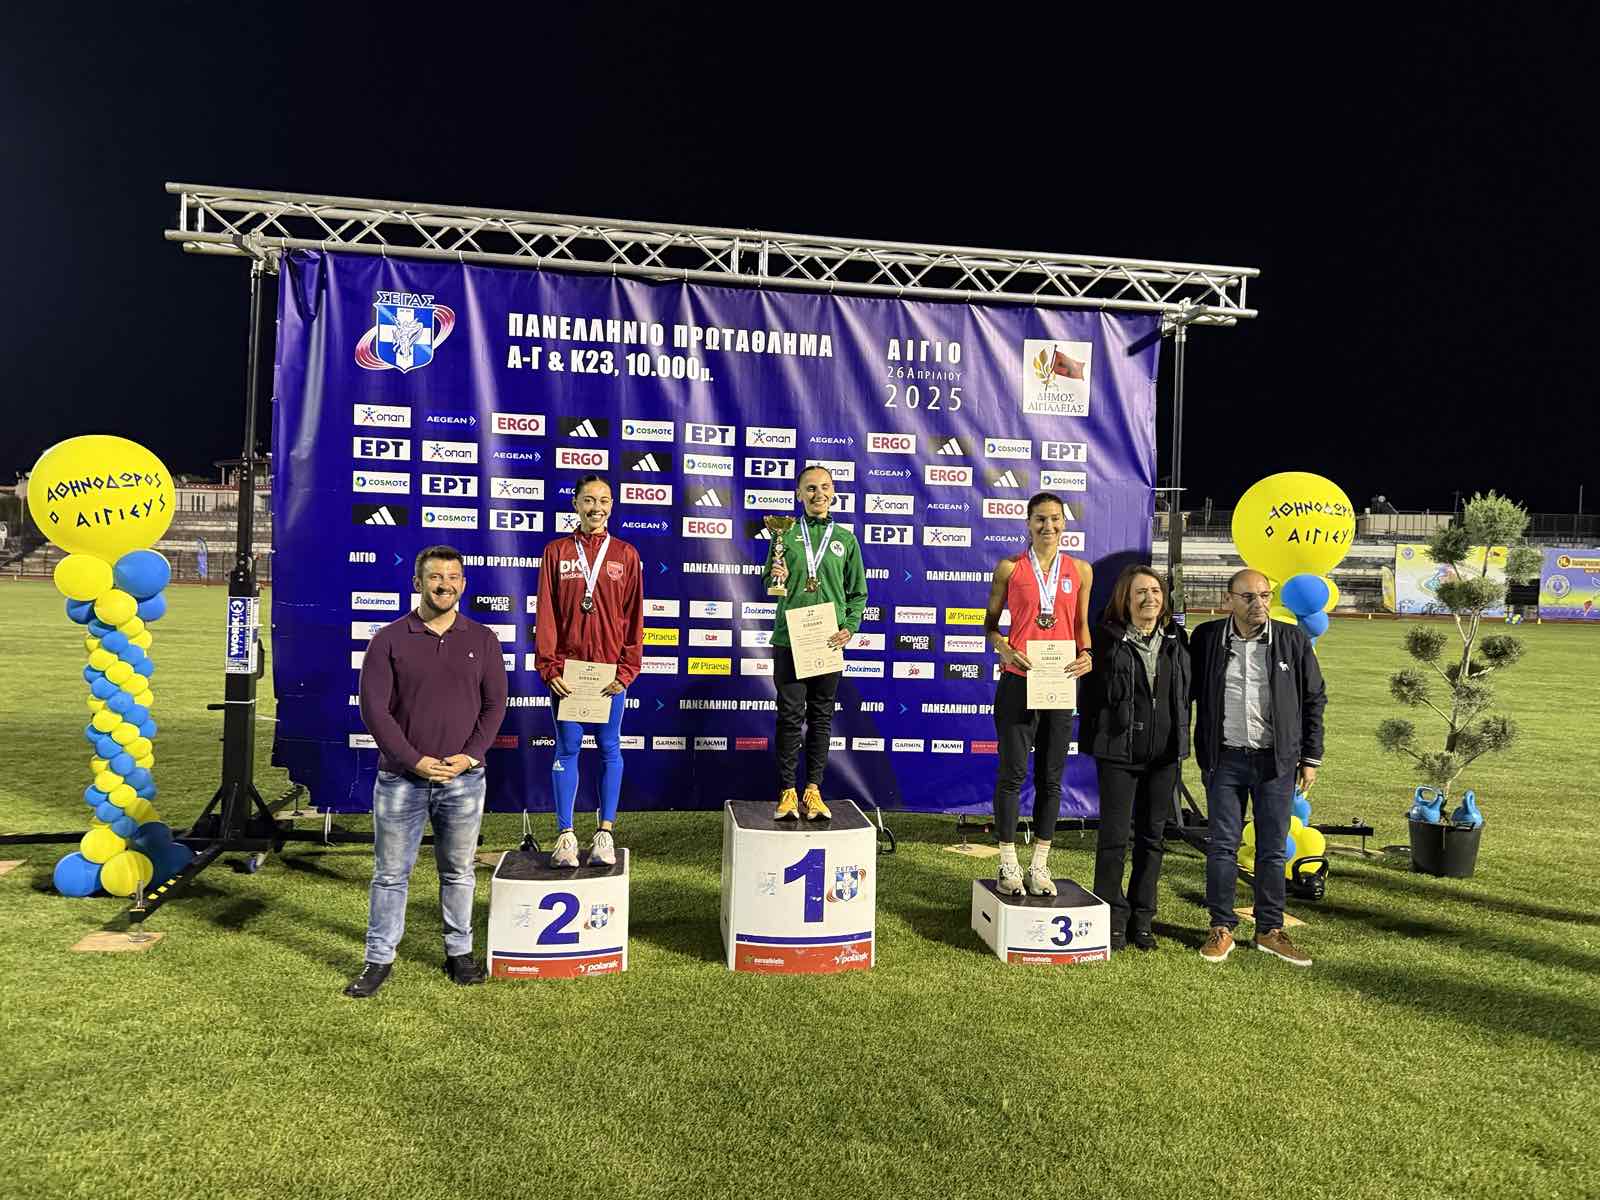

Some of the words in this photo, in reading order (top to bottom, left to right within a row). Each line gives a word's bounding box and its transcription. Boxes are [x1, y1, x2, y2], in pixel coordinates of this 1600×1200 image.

[376, 290, 435, 307] ΣΕΓΑΣ
[508, 313, 664, 346] ΠΑΝΕΛΛΗΝΙΟ
[674, 325, 833, 358] ΠΡΩΤΑΘΛΗΜΑ
[887, 339, 961, 364] ΑΙΓΙΟ
[507, 346, 542, 370] Α-Γ
[548, 351, 564, 372] &
[570, 349, 620, 376] Κ23,
[885, 384, 962, 411] 2025
[427, 415, 467, 425] AEGEAN
[498, 417, 540, 432] ERGO
[636, 428, 672, 436] COSMOTE
[809, 436, 846, 445] AEGEAN
[872, 437, 911, 450] ERGO
[493, 452, 533, 460] AEGEAN
[561, 452, 603, 466] ERGO
[868, 469, 904, 477] AEGEAN
[929, 470, 967, 482] ERGO
[369, 479, 408, 488] COSMOTE
[626, 487, 666, 501] ERGO
[758, 496, 793, 504] COSMOTE
[927, 503, 962, 511] AEGEAN
[988, 503, 1024, 516] ERGO
[437, 514, 476, 523] COSMOTE
[622, 521, 661, 530] AEGEAN
[688, 521, 727, 535] ERGO
[984, 535, 1018, 543] AEGEAN
[349, 551, 376, 563] ΑΙΓΙΟ
[683, 562, 741, 574] ΠΑΝΕΛΛΗΝΙΟ
[866, 568, 889, 579] ΑΙΓΙΟ
[926, 570, 983, 582] ΠΑΝΕΛΛΗΝΙΟ
[476, 596, 510, 604] POWER
[957, 610, 985, 620] Piraeus
[648, 632, 678, 642] Piraeus
[900, 635, 929, 644] POWER
[700, 661, 729, 671] Piraeus
[950, 664, 979, 673] POWER
[680, 699, 738, 710] ΠΑΝΕΛΛΗΝΙΟ
[860, 702, 884, 712] ΑΙΓΙΟ
[921, 703, 977, 714] ΠΑΝΕΛΛΗΝΙΟ
[784, 848, 825, 923] 1
[536, 892, 580, 945] 2
[1050, 915, 1073, 946] 3
